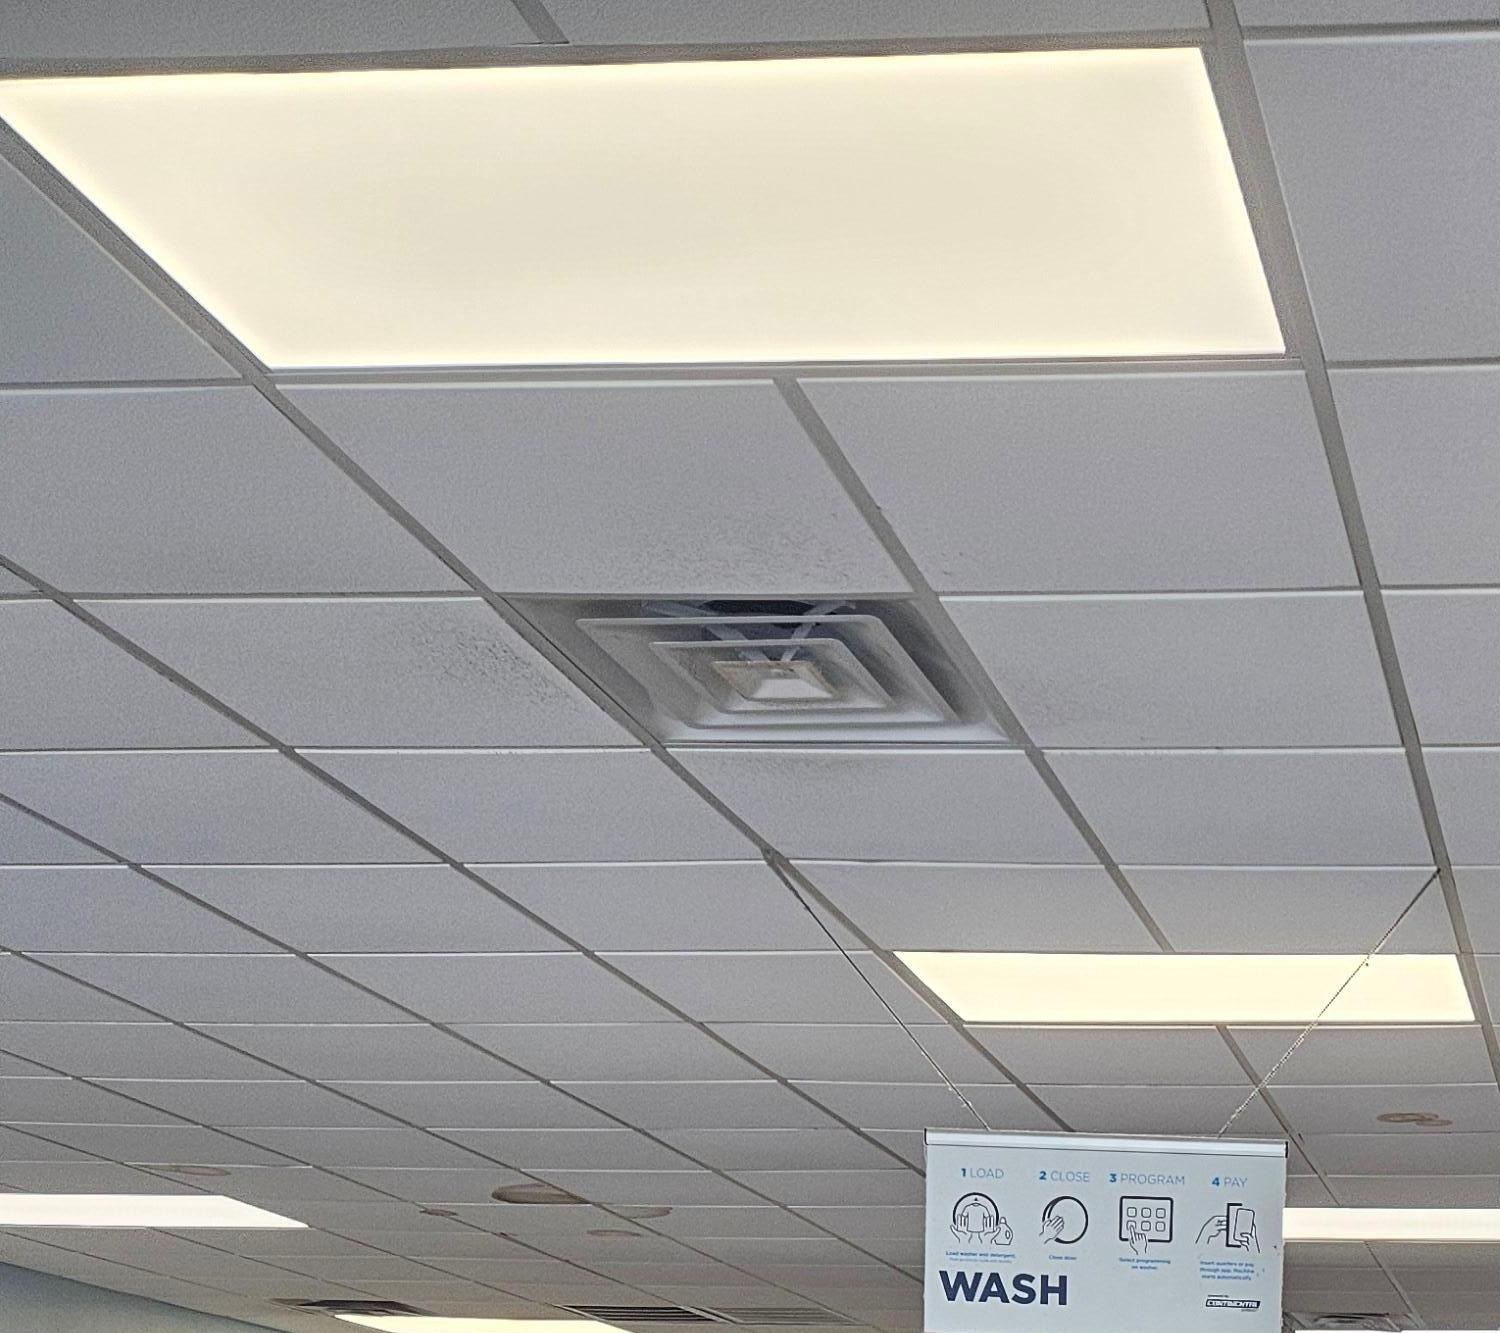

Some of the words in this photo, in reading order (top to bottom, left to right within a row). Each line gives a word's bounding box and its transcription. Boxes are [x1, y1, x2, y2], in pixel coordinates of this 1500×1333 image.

[961, 1167, 967, 1178] 1
[970, 1168, 1005, 1180] LOAD
[1038, 1170, 1047, 1181] 2
[1050, 1171, 1091, 1183] CLOSE
[1109, 1173, 1117, 1183] 3
[1120, 1174, 1185, 1186] PROGRAM
[1211, 1177, 1220, 1187] 4
[1223, 1177, 1247, 1188] PAY
[938, 1270, 1068, 1306] WASH
